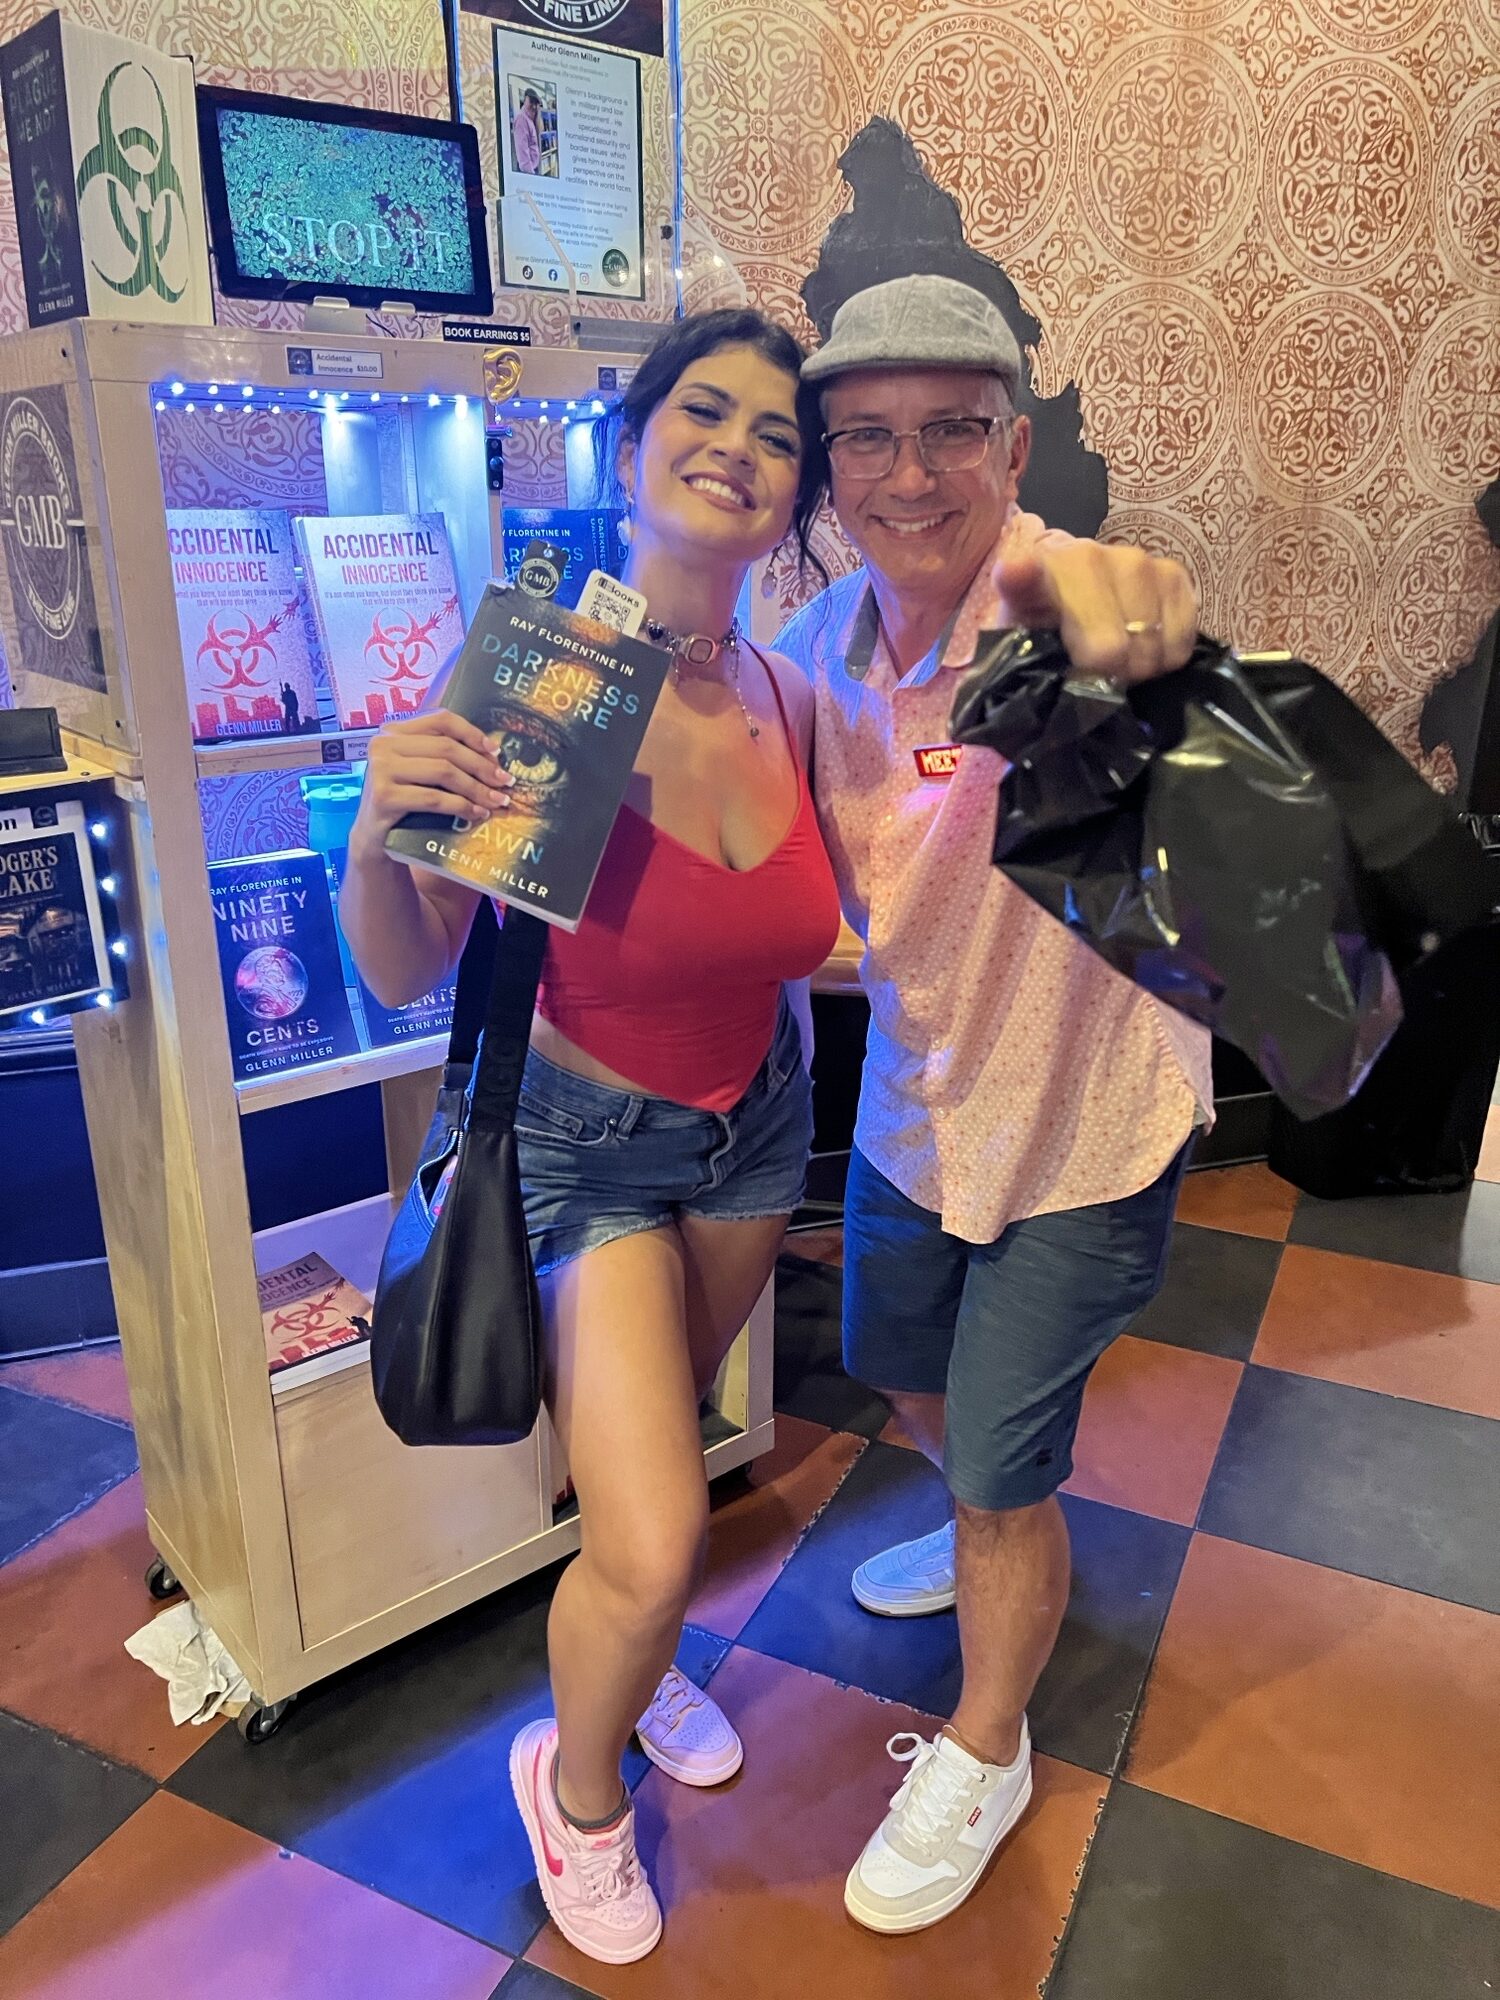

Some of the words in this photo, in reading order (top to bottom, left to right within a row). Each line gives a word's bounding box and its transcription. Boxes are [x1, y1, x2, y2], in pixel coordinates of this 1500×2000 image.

[543, 1, 583, 22] FINE
[531, 41, 557, 53] Author
[558, 47, 580, 59] Glenn
[581, 52, 601, 63] Miller
[588, 91, 622, 105] background
[570, 143, 589, 152] border
[261, 213, 395, 270] STOP
[401, 226, 452, 274] IT
[444, 326, 472, 338] BOOK
[473, 328, 519, 341] EARRINGS
[520, 332, 530, 342] $5
[316, 353, 352, 362] Accidental
[318, 365, 354, 374] Innocence
[40, 425, 70, 509] BOOKS
[14, 495, 67, 549] GMB
[508, 529, 560, 537] FLORENTINE
[561, 529, 571, 537] IN
[167, 528, 279, 556] CCIDENTAL
[323, 531, 439, 559] ACCIDENTAL
[175, 561, 269, 584] INNOCENCE
[342, 562, 429, 585] INNOCENCE
[525, 570, 551, 587] GMB
[510, 616, 536, 632] RAY
[538, 627, 619, 669] FLORENTINE
[619, 662, 634, 677] IN
[481, 633, 641, 715] DARKNESS
[493, 666, 610, 731] BEFORE
[216, 720, 248, 736] GLENN
[248, 718, 282, 734] MILLER
[451, 815, 545, 865] DAWN
[425, 839, 482, 872] GLENN
[488, 865, 550, 899] MILLER
[230, 878, 290, 893] FLORENTINE
[291, 876, 303, 885] IN
[212, 889, 308, 921] NINETY
[230, 914, 297, 943] NINE
[246, 1018, 320, 1046] CENTS
[394, 1021, 431, 1035] GLENN
[434, 1016, 454, 1027] MIL
[245, 1056, 286, 1072] GLENN
[290, 1046, 333, 1062] MILLER
[262, 1276, 315, 1302] OCENCE
